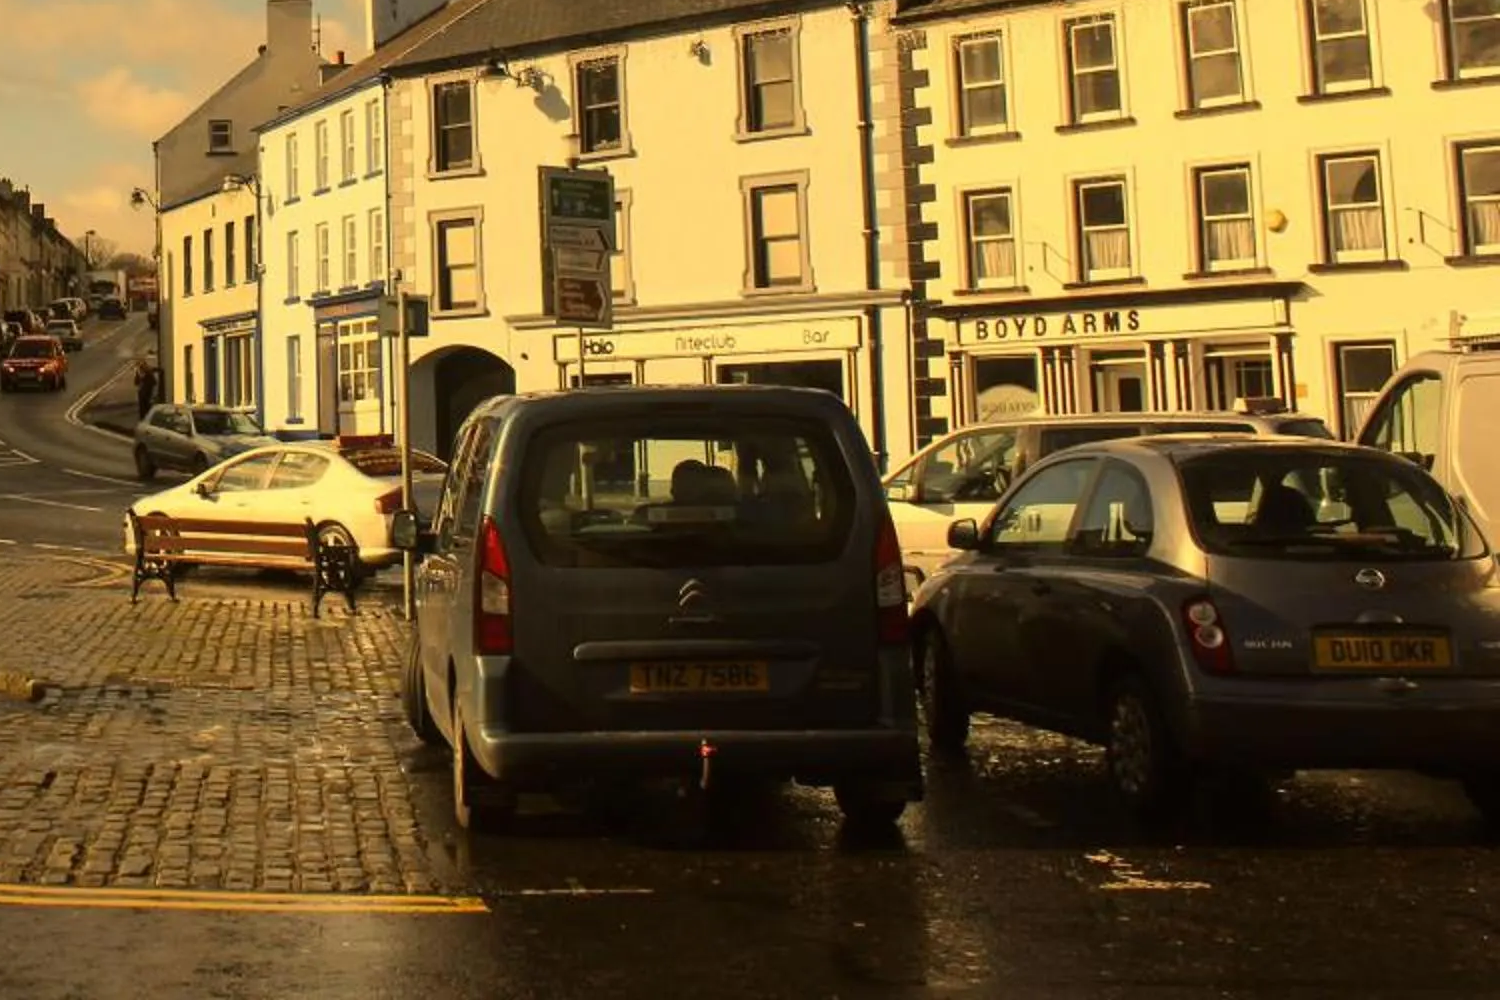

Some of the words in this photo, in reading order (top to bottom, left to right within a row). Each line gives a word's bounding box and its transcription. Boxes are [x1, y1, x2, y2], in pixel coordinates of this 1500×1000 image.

[976, 316, 1047, 340] BOYD
[1062, 309, 1140, 335] ARMS
[803, 328, 830, 345] Bar
[1330, 640, 1383, 663] DU10
